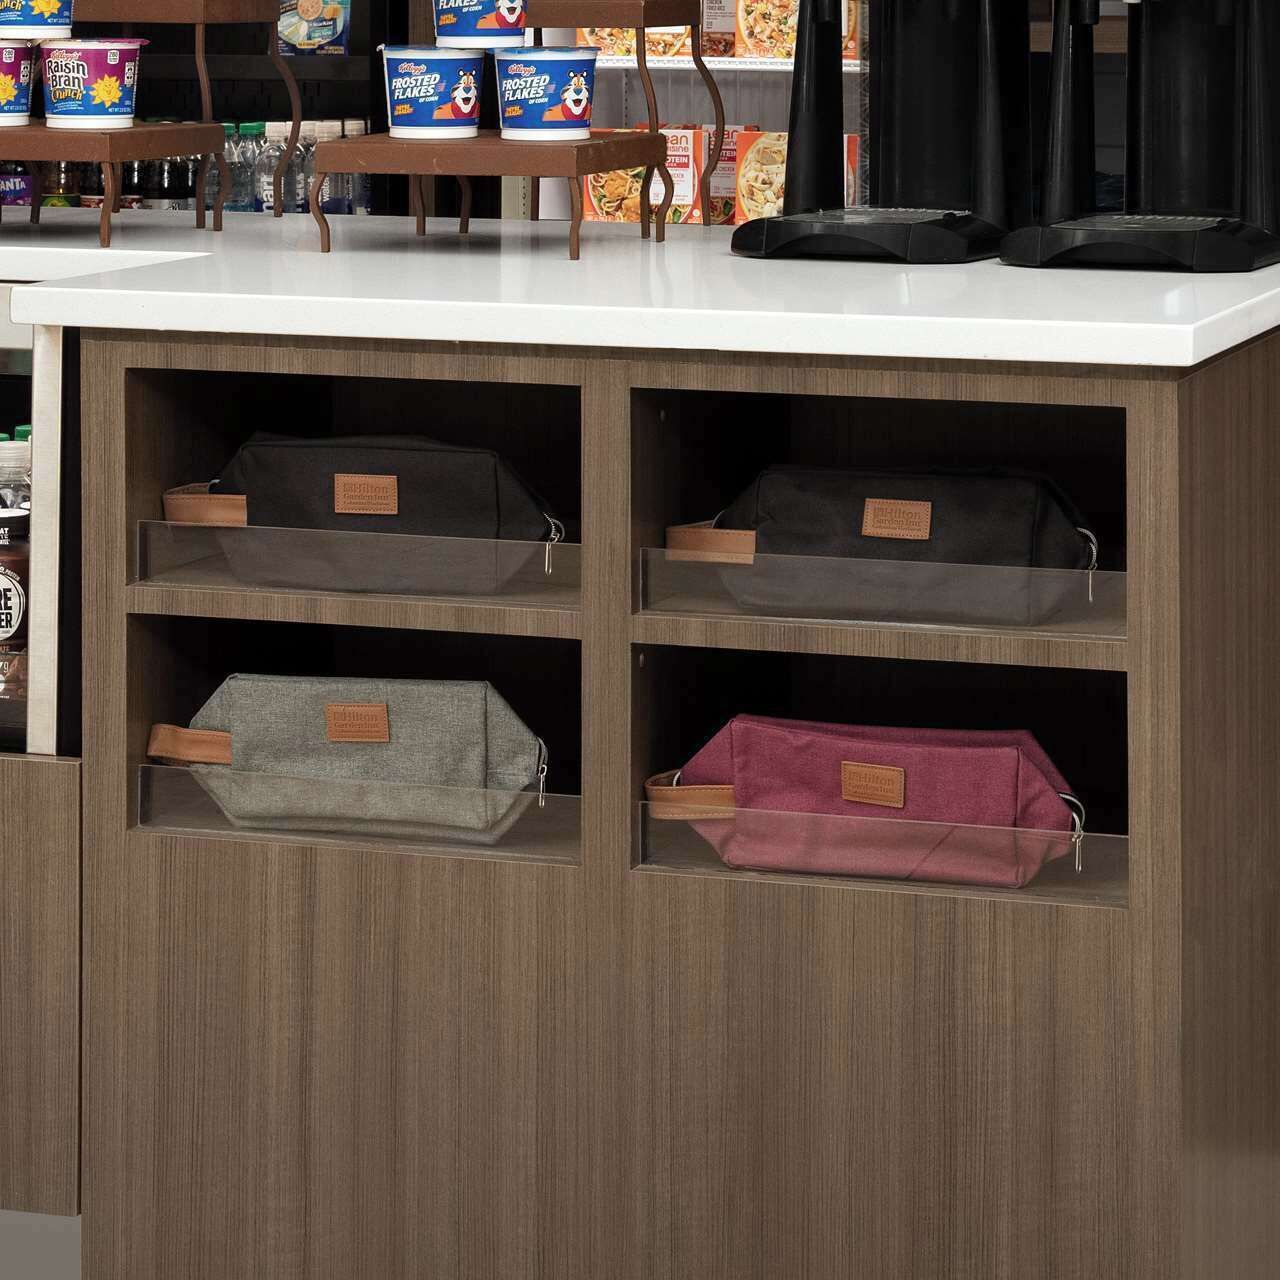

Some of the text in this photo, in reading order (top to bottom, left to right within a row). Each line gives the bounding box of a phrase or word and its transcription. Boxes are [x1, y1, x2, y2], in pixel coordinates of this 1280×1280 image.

[47, 60, 87, 76] Raisin
[398, 62, 427, 74] Kellogg's
[508, 64, 537, 75] Kellogg's
[51, 74, 82, 90] Bran
[392, 74, 440, 89] FROSTED
[502, 75, 550, 91] FROSTED
[51, 88, 83, 102] Crunch
[394, 85, 435, 101] FLAKES
[425, 95, 439, 103] CORN
[504, 86, 544, 102] FLAKES
